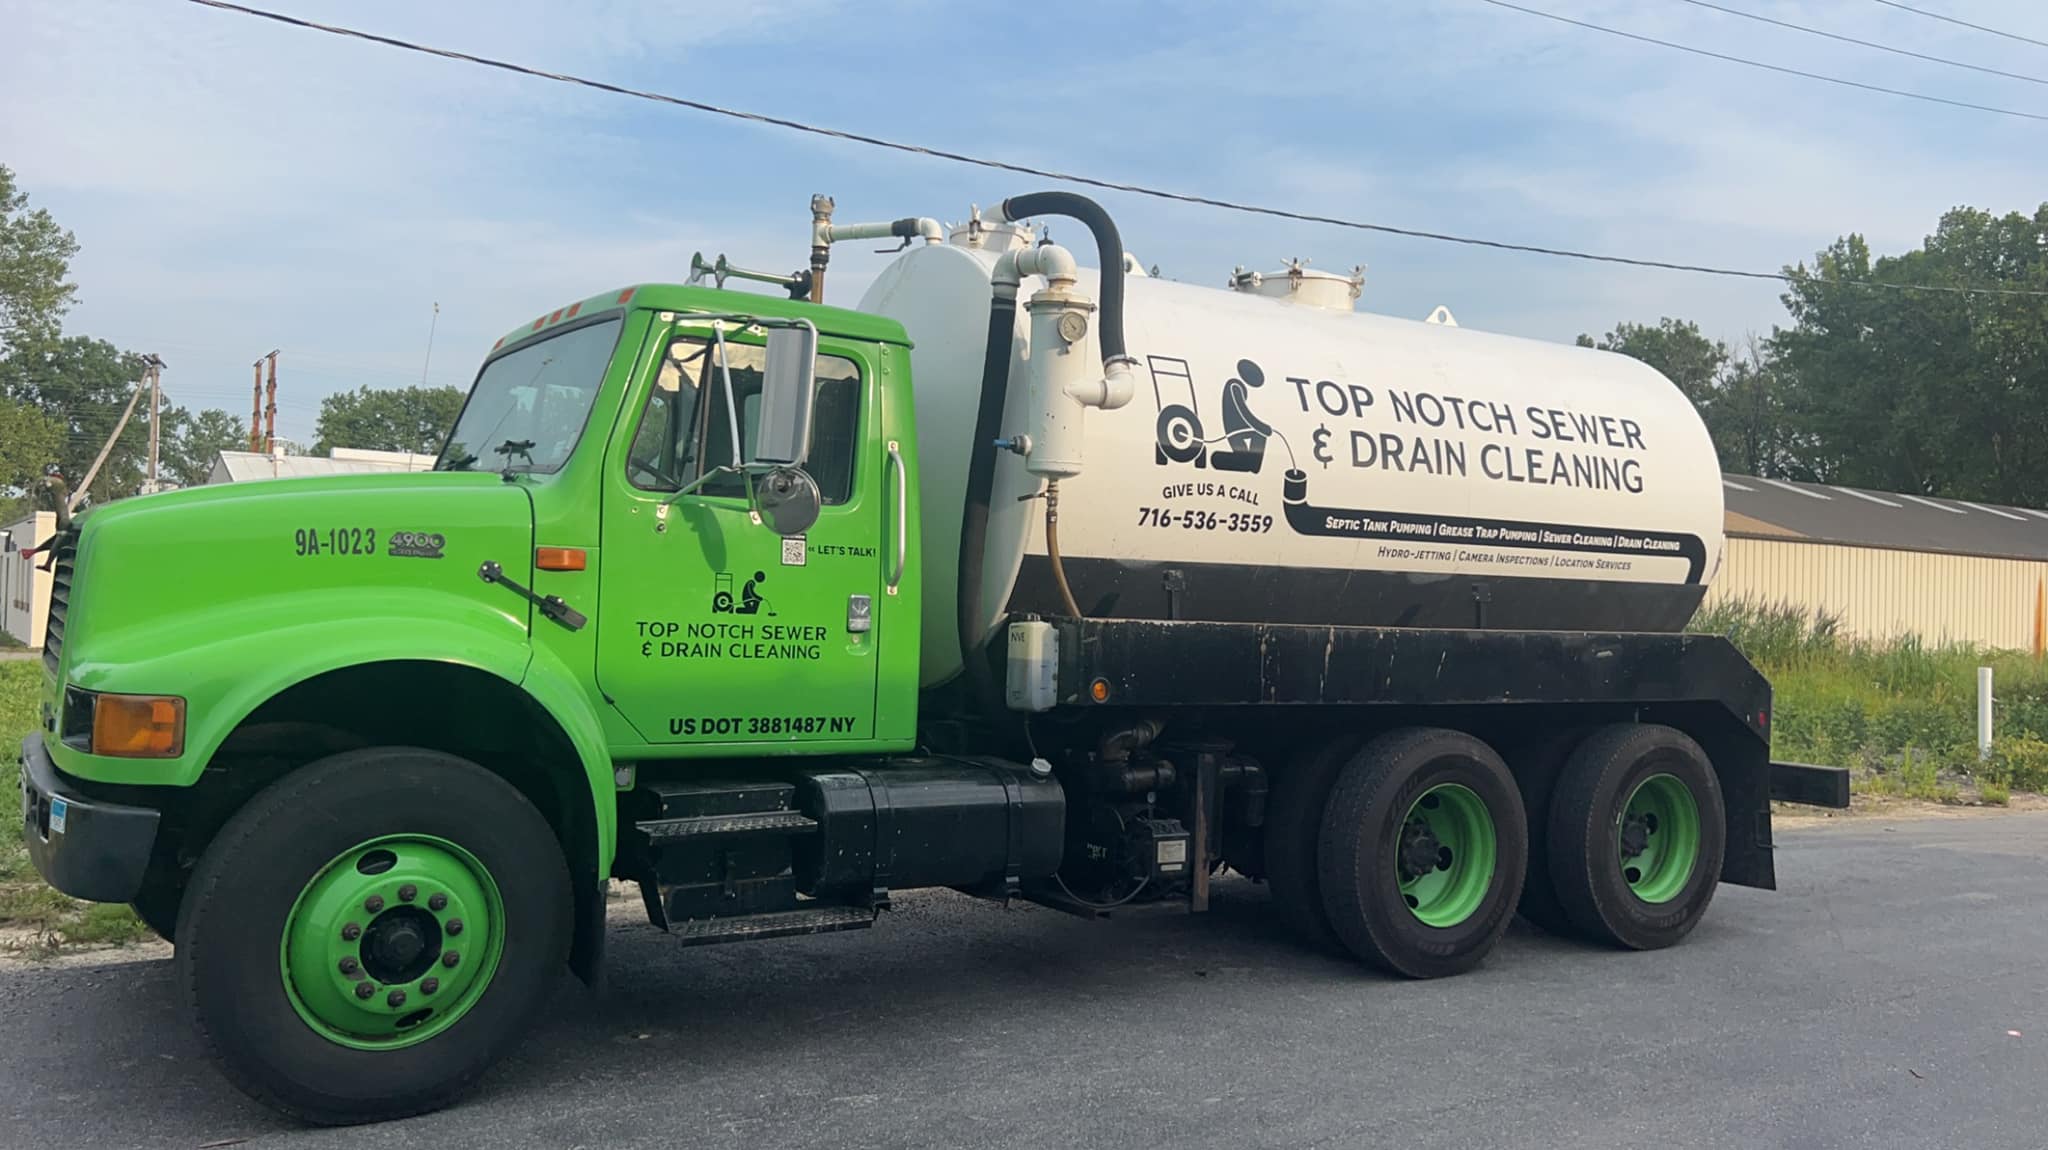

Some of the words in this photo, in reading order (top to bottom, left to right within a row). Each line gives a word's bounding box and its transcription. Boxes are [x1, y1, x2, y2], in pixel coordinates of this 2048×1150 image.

[1286, 377, 1374, 418] TOP
[1388, 389, 1517, 435] NOTCH
[1526, 407, 1647, 450] SEWER
[1312, 423, 1334, 469] &
[1350, 430, 1467, 477] DRAIN
[1481, 444, 1643, 493] CLEANING
[1162, 483, 1194, 499] GIVE
[1197, 483, 1214, 496] US
[1216, 484, 1226, 497] A
[1229, 487, 1259, 506] CALL
[1138, 507, 1273, 534] 716-536-3559
[295, 528, 376, 556] 9A-1023
[389, 531, 446, 549] 4900
[818, 545, 846, 556] LET'S
[847, 546, 877, 557] TALK!
[636, 622, 679, 638] TOP
[687, 623, 753, 639] NOTCH
[761, 625, 827, 641] SEWER
[641, 641, 653, 658] &
[661, 642, 722, 658] DRAIN
[729, 643, 820, 660] CLEANING
[669, 718, 696, 735] US
[701, 718, 743, 734] DOT
[748, 717, 826, 734] 3881487
[830, 717, 856, 733] NY
